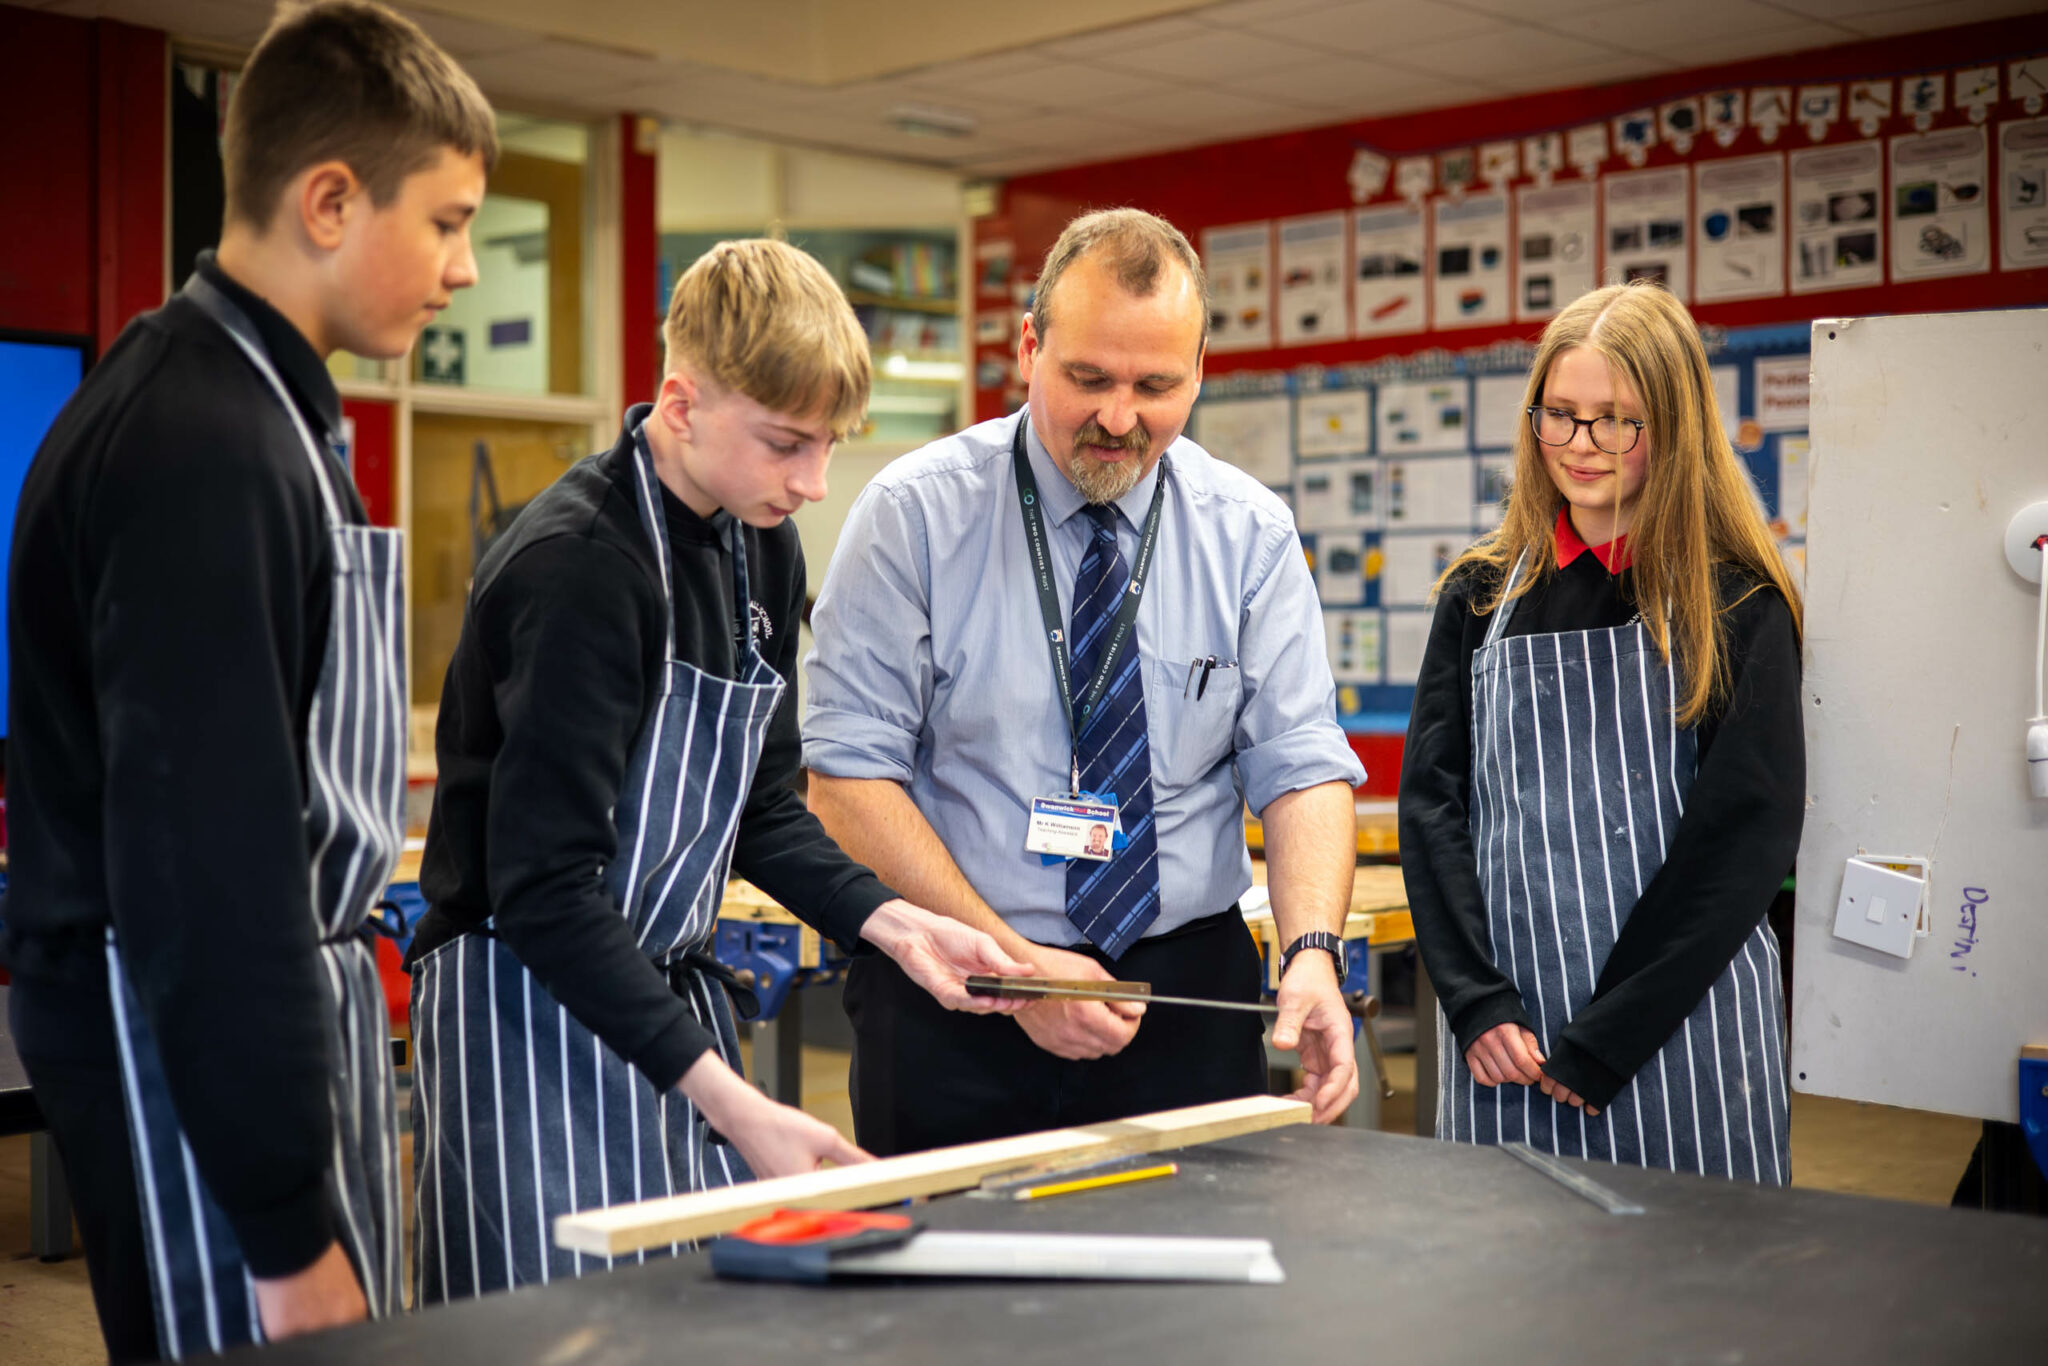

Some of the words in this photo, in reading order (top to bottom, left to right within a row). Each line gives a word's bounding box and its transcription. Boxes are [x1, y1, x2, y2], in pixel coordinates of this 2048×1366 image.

[1034, 538, 1045, 570] COUNTIES
[1040, 570, 1049, 592] TRUST
[1137, 547, 1148, 580] SWANWICK
[758, 606, 774, 640] SCHOOL
[1056, 646, 1066, 681] SWANWICK
[1088, 690, 1098, 701] THE
[1095, 674, 1105, 689] TWO
[1102, 642, 1118, 674] COUNTIES
[1114, 622, 1126, 642] TRUST
